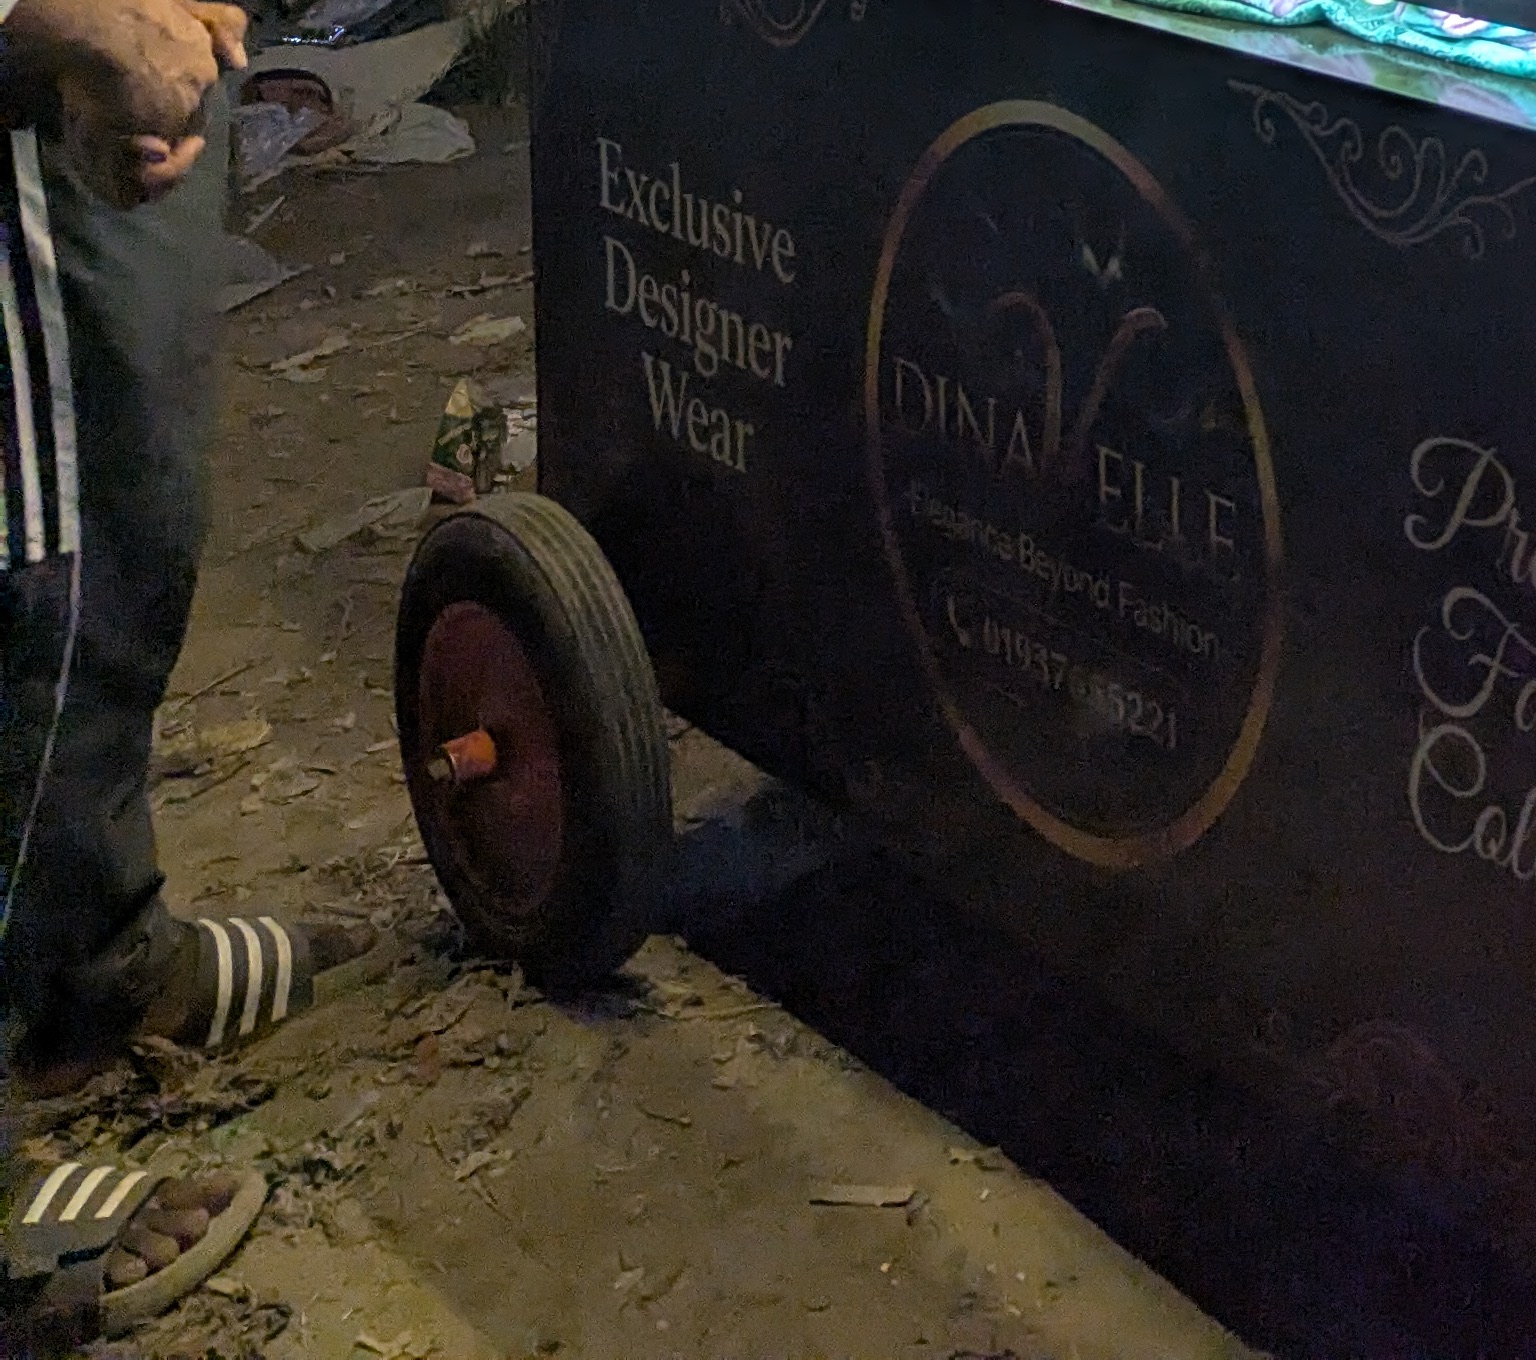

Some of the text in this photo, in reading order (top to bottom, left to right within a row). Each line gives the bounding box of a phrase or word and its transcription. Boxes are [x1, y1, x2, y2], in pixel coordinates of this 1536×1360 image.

[598, 137, 797, 283] Exclusive
[603, 235, 793, 387] Designer
[641, 352, 755, 474] Wear
